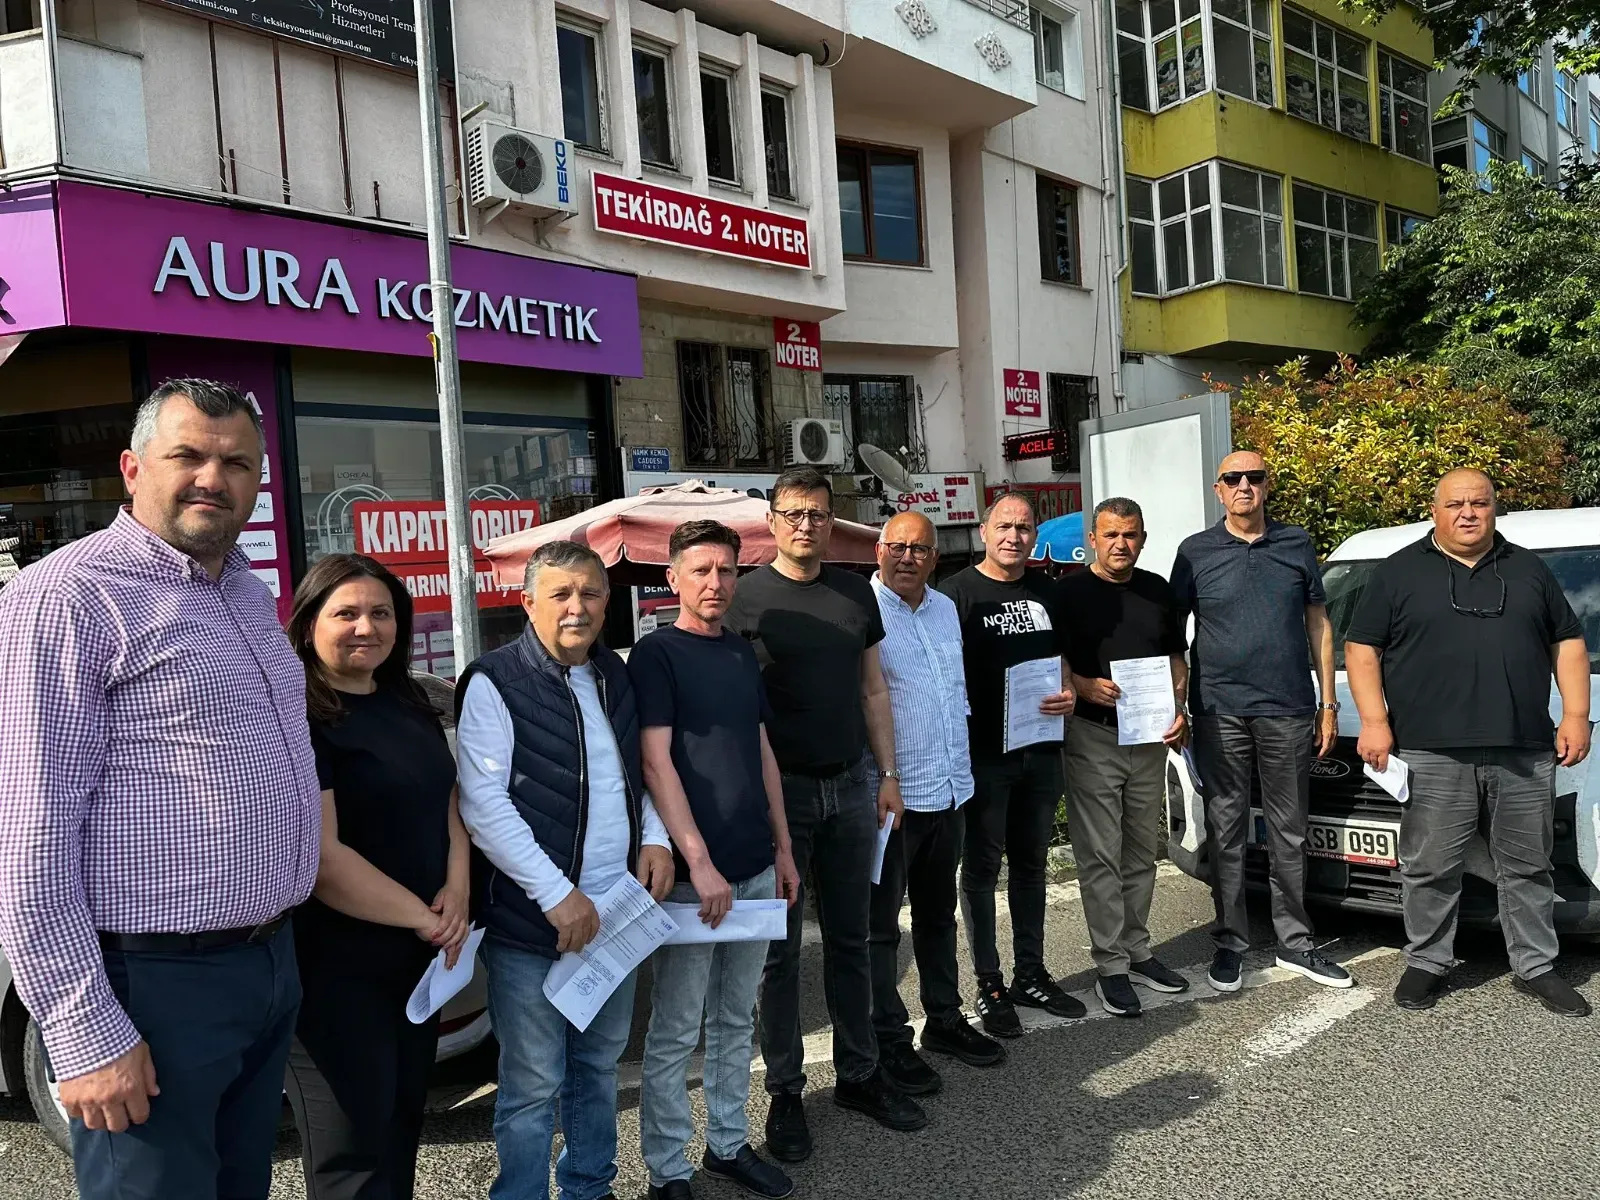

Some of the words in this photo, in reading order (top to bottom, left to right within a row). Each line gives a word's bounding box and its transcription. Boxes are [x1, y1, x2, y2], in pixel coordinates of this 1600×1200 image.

[331, 0, 390, 25] Profesyonel
[391, 16, 416, 33] Temi
[331, 13, 386, 39] Hizmetleri
[263, 15, 372, 53] teksiteyonetimi@gmail.com
[400, 55, 418, 67] tekyo
[555, 139, 570, 204] BEKO
[597, 186, 713, 237] TEKİRDAĞ
[720, 215, 739, 242] 2.
[743, 219, 807, 256] NOTER
[153, 235, 360, 315] AURA
[787, 323, 807, 343] 2.
[776, 342, 819, 369] NOTER
[1017, 373, 1028, 387] 2.
[1006, 386, 1040, 404] NOTER
[650, 449, 668, 457] KEMAL
[1018, 438, 1055, 454] ACELE
[1001, 600, 1028, 613] THE
[983, 610, 1031, 628] NORTH
[1001, 622, 1035, 636] FACE
[1348, 831, 1389, 856] 099
